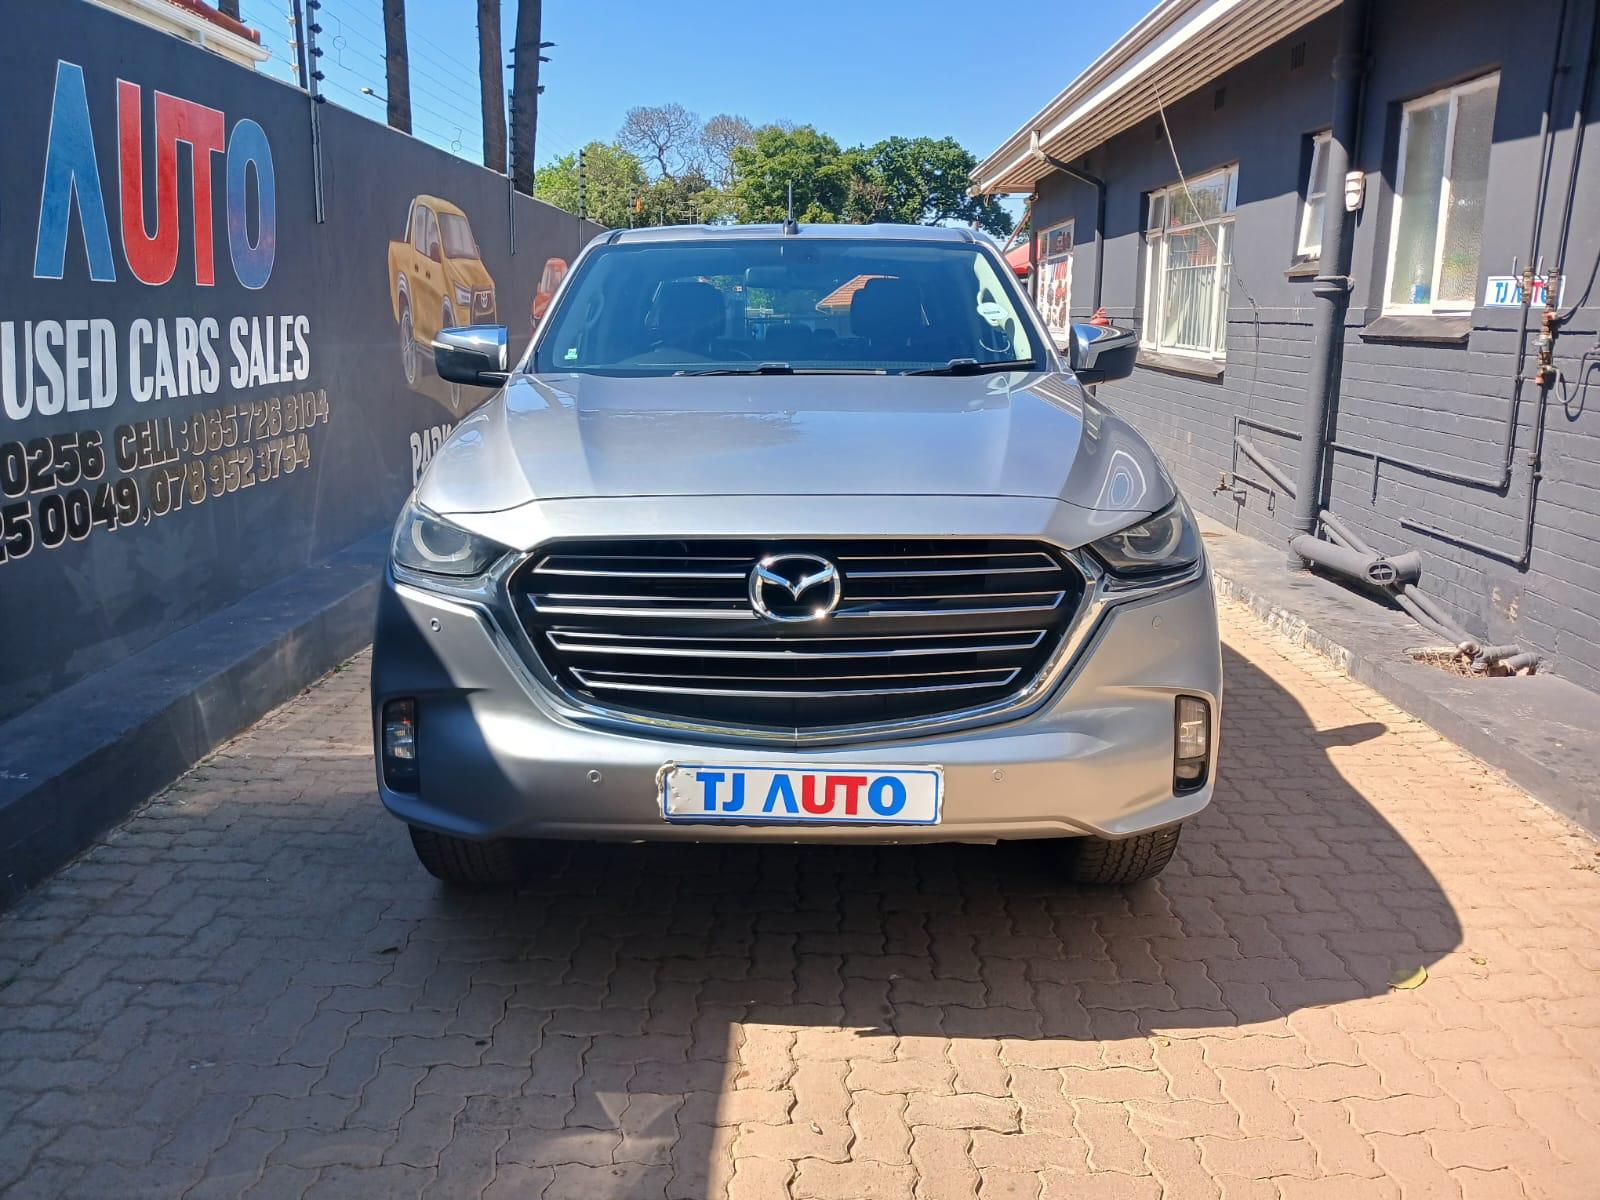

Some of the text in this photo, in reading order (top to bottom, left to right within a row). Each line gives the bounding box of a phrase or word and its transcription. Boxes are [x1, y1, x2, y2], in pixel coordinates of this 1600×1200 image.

[33, 58, 276, 290] AUTO
[1495, 281, 1547, 304] TJ AT
[0, 315, 310, 421] USED CARS SALES
[0, 429, 106, 499] 0256
[240, 396, 282, 444] 726
[209, 447, 256, 498] 952
[696, 772, 907, 817] TJ AUTO
